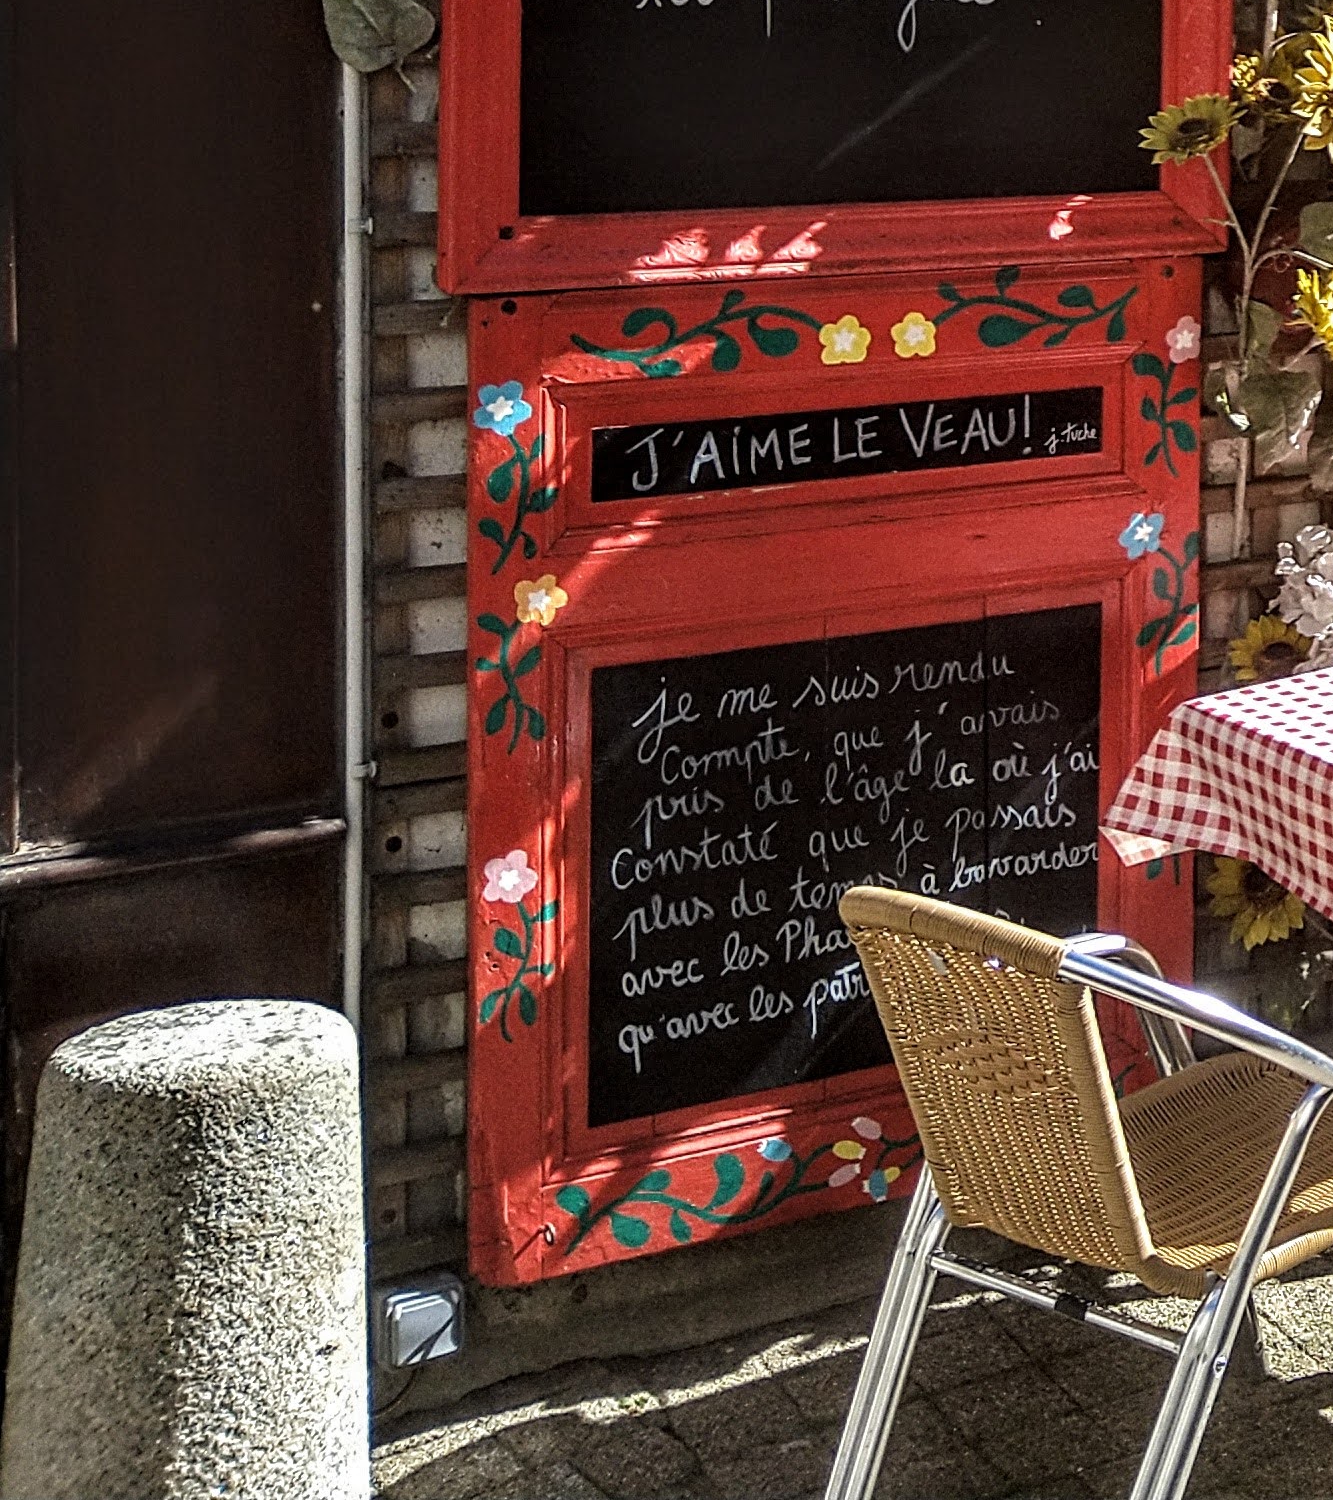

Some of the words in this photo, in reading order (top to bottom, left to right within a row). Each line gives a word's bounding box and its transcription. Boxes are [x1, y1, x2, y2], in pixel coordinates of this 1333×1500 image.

[832, 414, 884, 465] LE
[898, 394, 1031, 458] VEAU!
[717, 682, 778, 719] me
[793, 665, 880, 709] suis
[888, 652, 1016, 695] rendu
[754, 765, 799, 812] de
[819, 762, 910, 826] l'âge
[992, 741, 1033, 783] où
[1041, 740, 1099, 806] j'ai
[833, 724, 885, 772] que
[809, 822, 870, 859] que
[889, 808, 931, 878] je
[945, 802, 1077, 864] passais
[612, 894, 716, 963] plus
[731, 877, 772, 921] de
[920, 862, 941, 896] à
[620, 956, 706, 999] avec
[720, 930, 771, 978] les
[748, 984, 795, 1024] les
